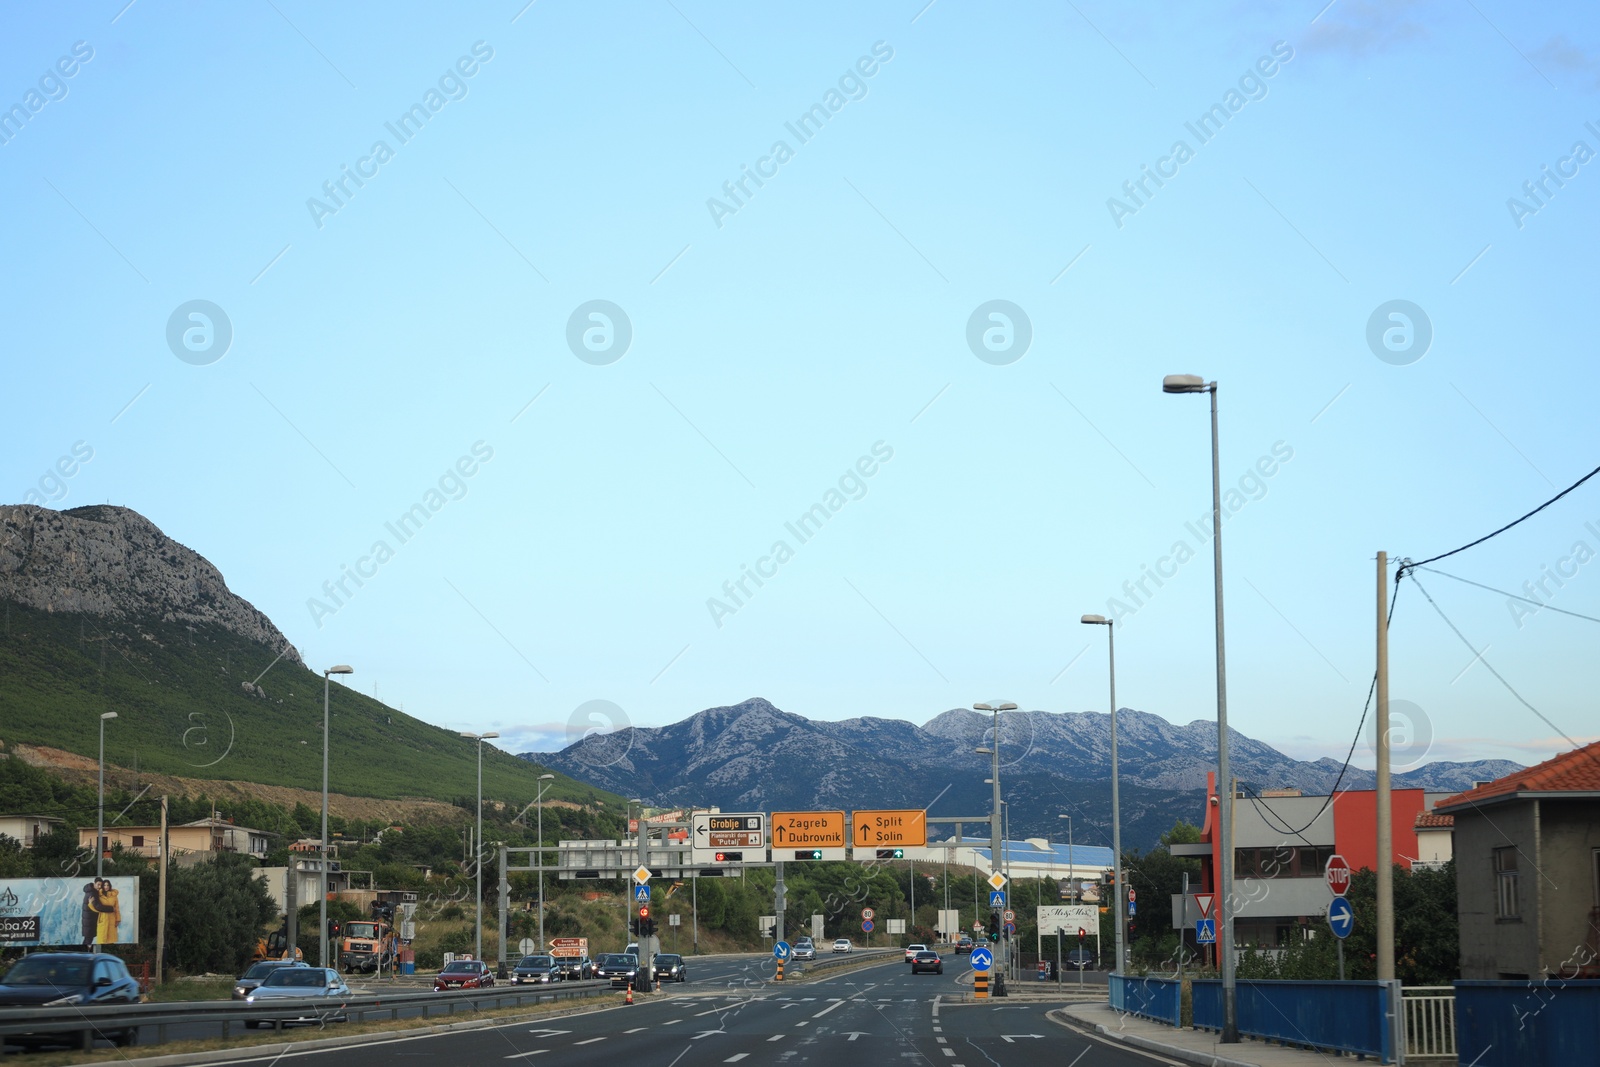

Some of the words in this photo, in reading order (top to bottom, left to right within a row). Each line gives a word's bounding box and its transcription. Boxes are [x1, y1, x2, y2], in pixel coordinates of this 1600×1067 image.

[711, 819, 739, 830] Groblje
[789, 818, 828, 831] Zagreb
[875, 816, 903, 829] Split
[789, 831, 841, 843] Dubrovnik
[876, 831, 903, 841] Solin
[1328, 867, 1349, 884] STOP
[864, 910, 872, 918] 80
[1005, 912, 1013, 920] 80
